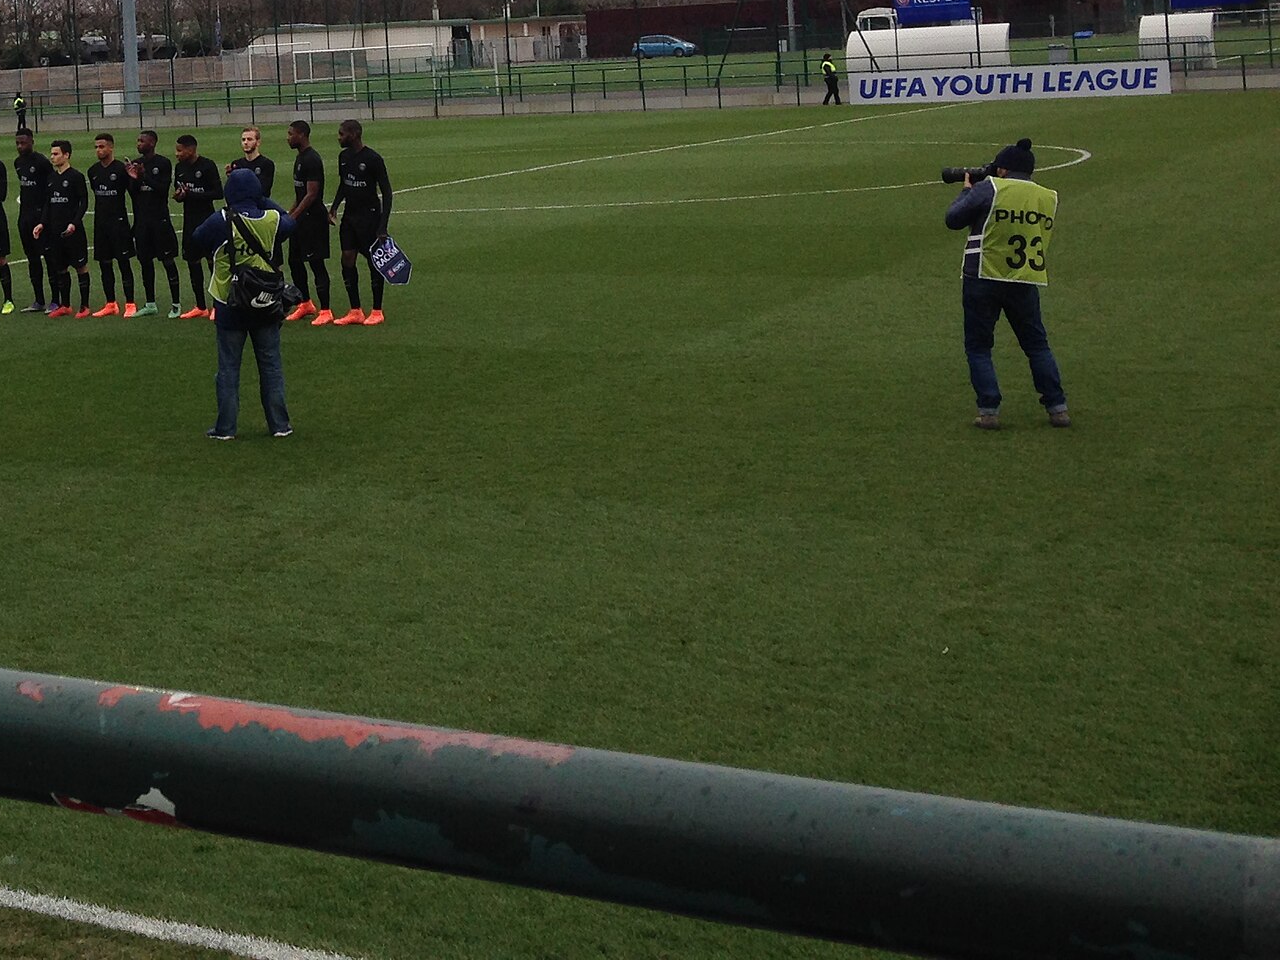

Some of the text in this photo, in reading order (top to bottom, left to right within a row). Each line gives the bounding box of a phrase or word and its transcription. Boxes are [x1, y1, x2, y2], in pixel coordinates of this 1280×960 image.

[859, 66, 1159, 100] UEFA YOUTH LEAGUE
[995, 209, 1054, 231] PHOTO
[372, 248, 385, 262] NO
[1005, 234, 1046, 271] 33
